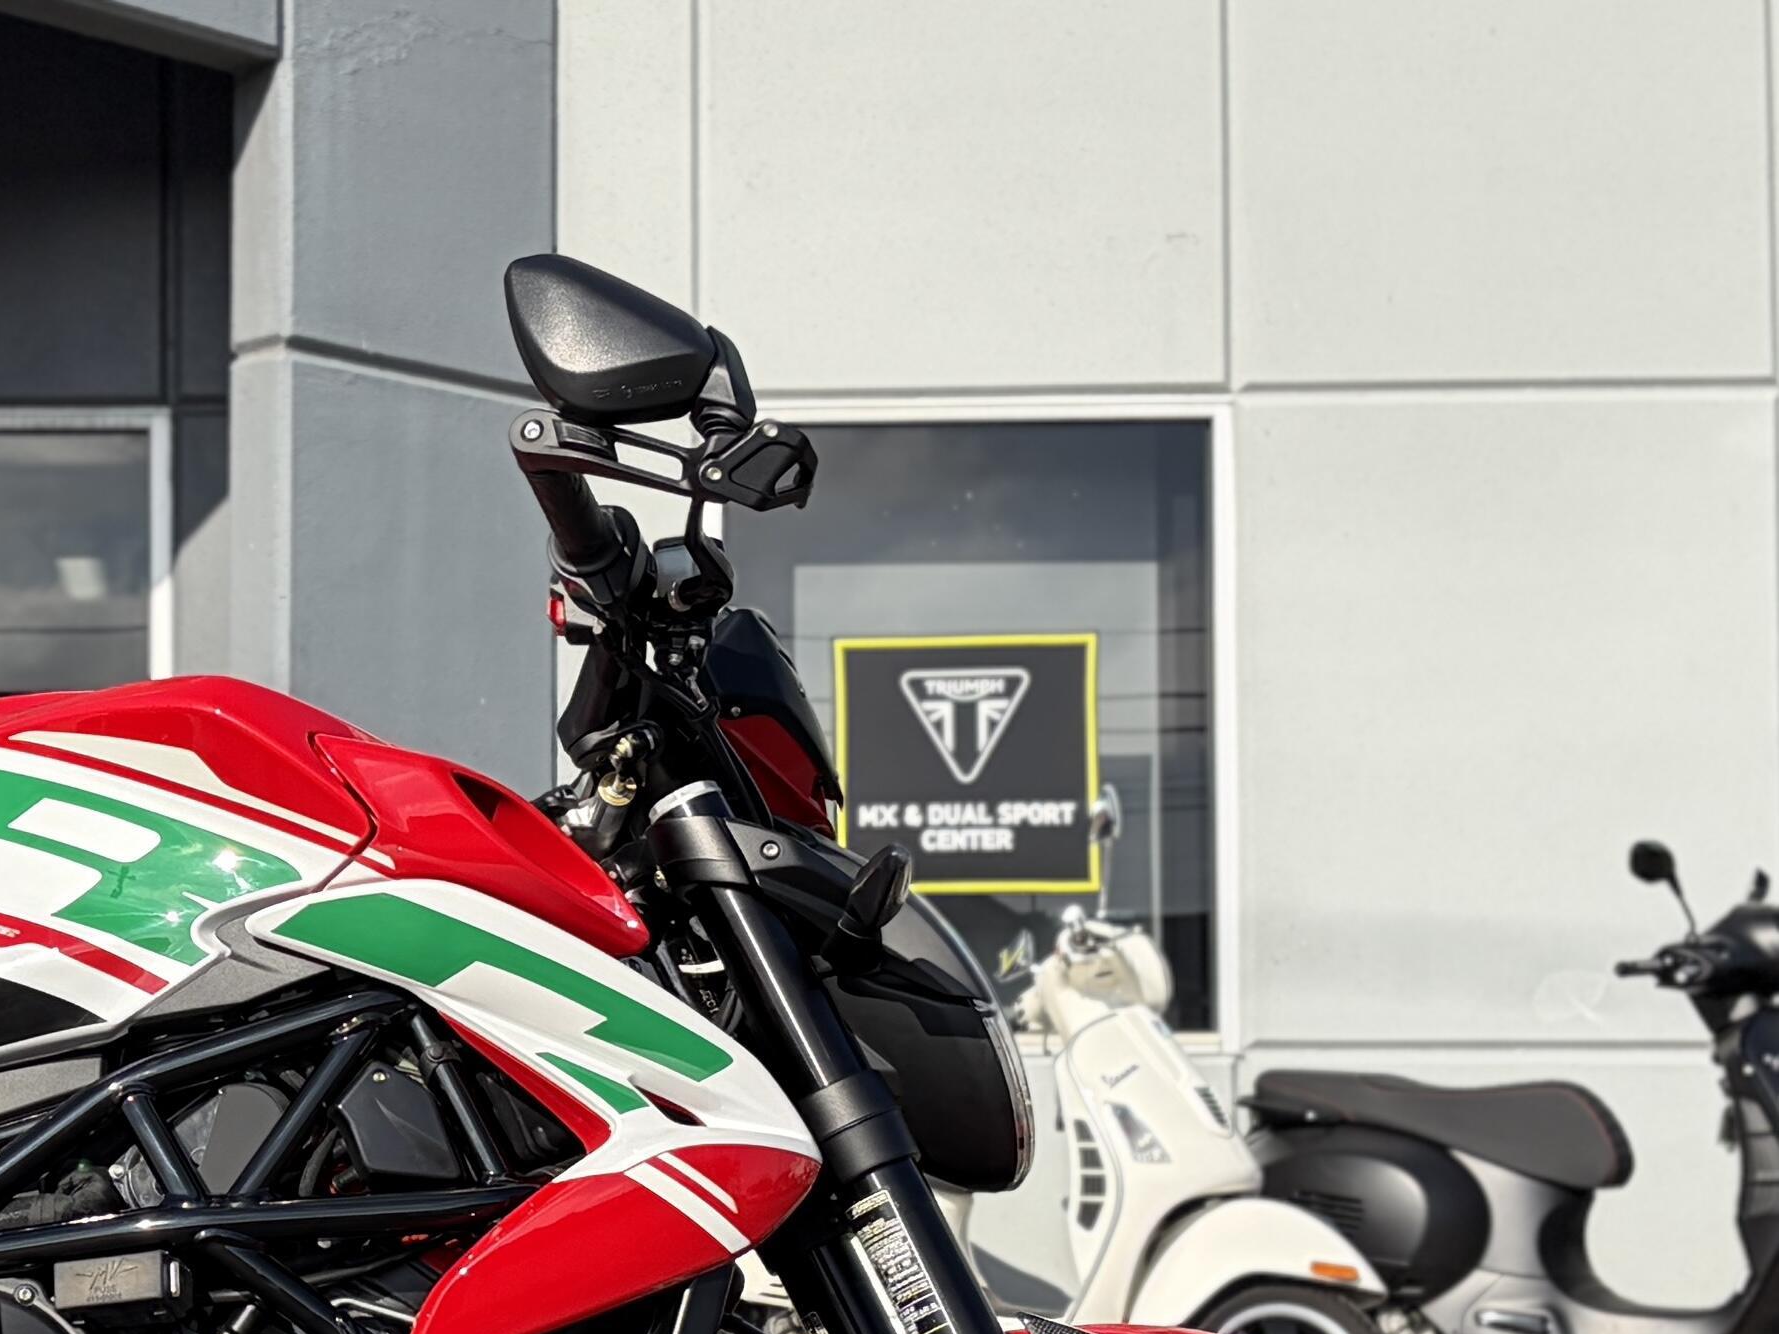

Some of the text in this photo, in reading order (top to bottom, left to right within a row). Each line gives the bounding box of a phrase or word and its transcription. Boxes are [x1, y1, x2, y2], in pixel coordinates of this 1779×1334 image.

[924, 678, 1005, 697] TRIUMPH
[858, 802, 1077, 828] MX & DUAL SPORT
[921, 829, 1014, 852] CENTER
